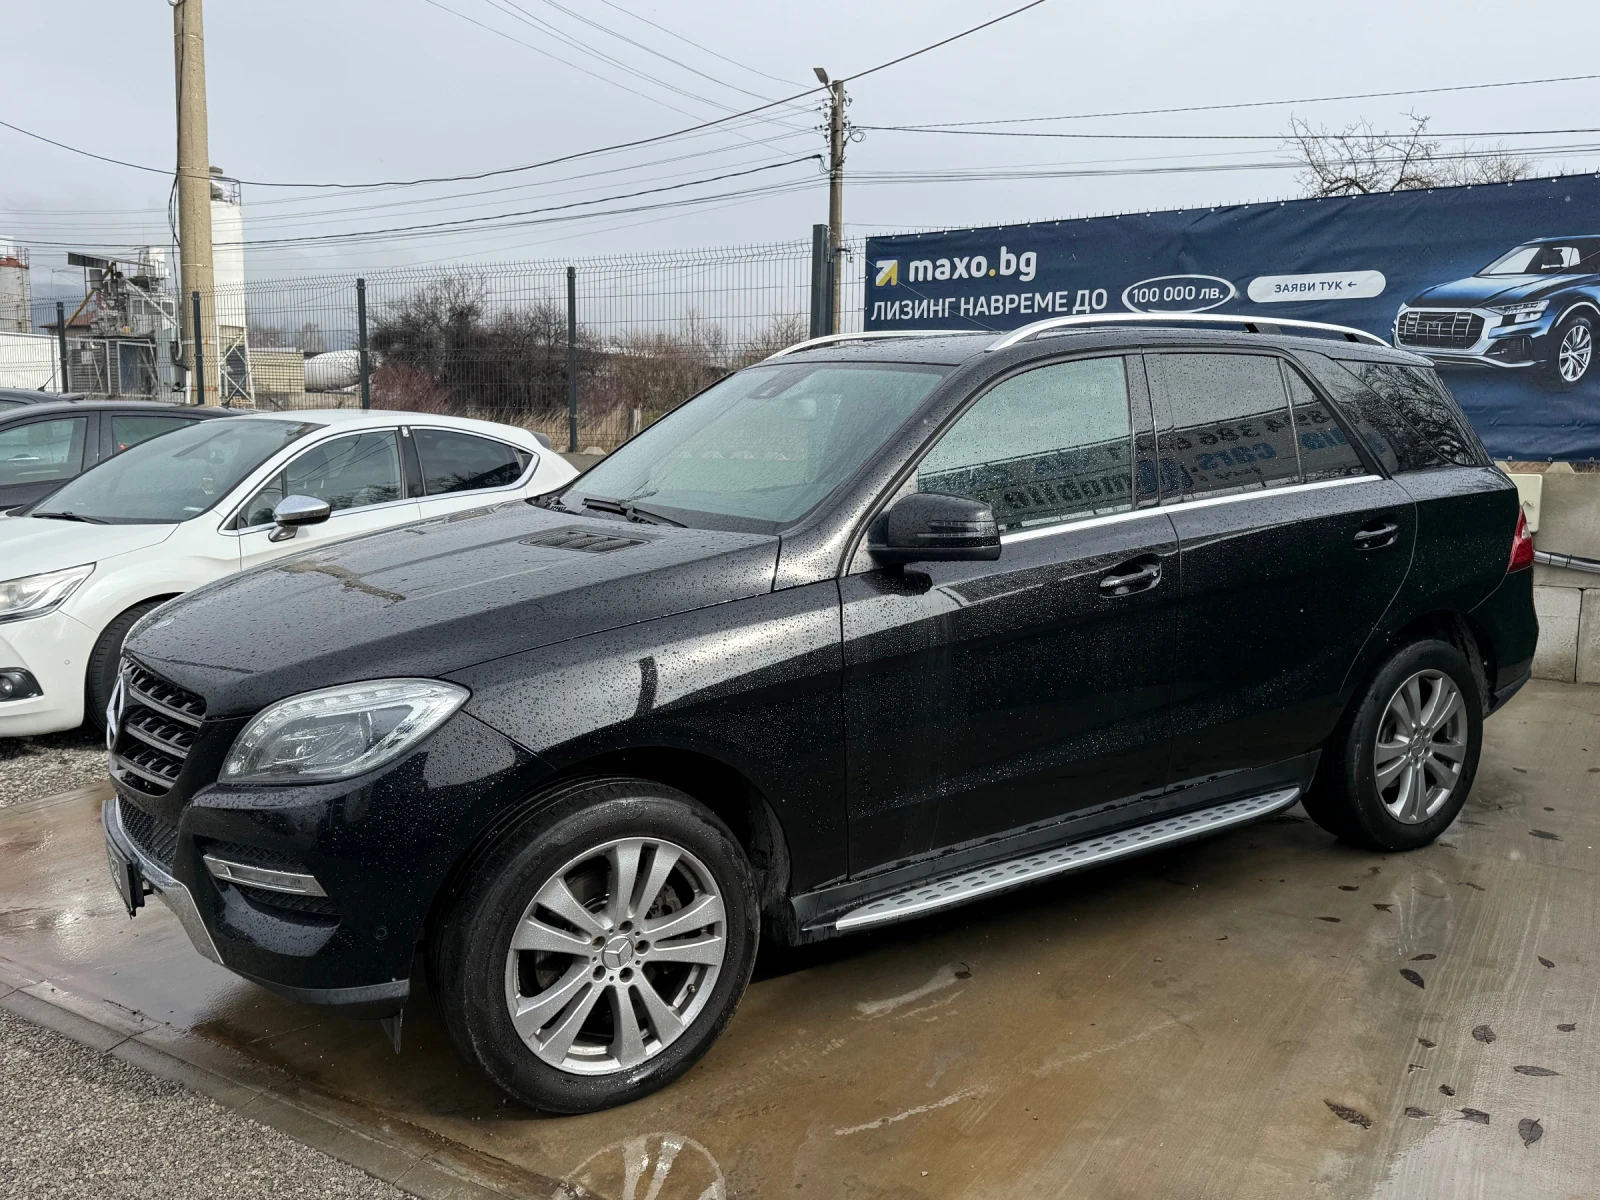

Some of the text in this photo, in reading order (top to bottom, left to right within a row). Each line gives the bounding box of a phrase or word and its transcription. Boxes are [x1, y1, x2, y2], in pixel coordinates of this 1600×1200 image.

[908, 245, 1037, 282] maxo.bg
[870, 297, 956, 321] ЛИЗИНГ
[960, 290, 1068, 317] НАВРЕМЕ
[1072, 288, 1108, 314] ДО
[1131, 287, 1160, 303] 100
[1163, 285, 1196, 301] 000
[1274, 281, 1343, 293] ЗАЯВИ ТУК
